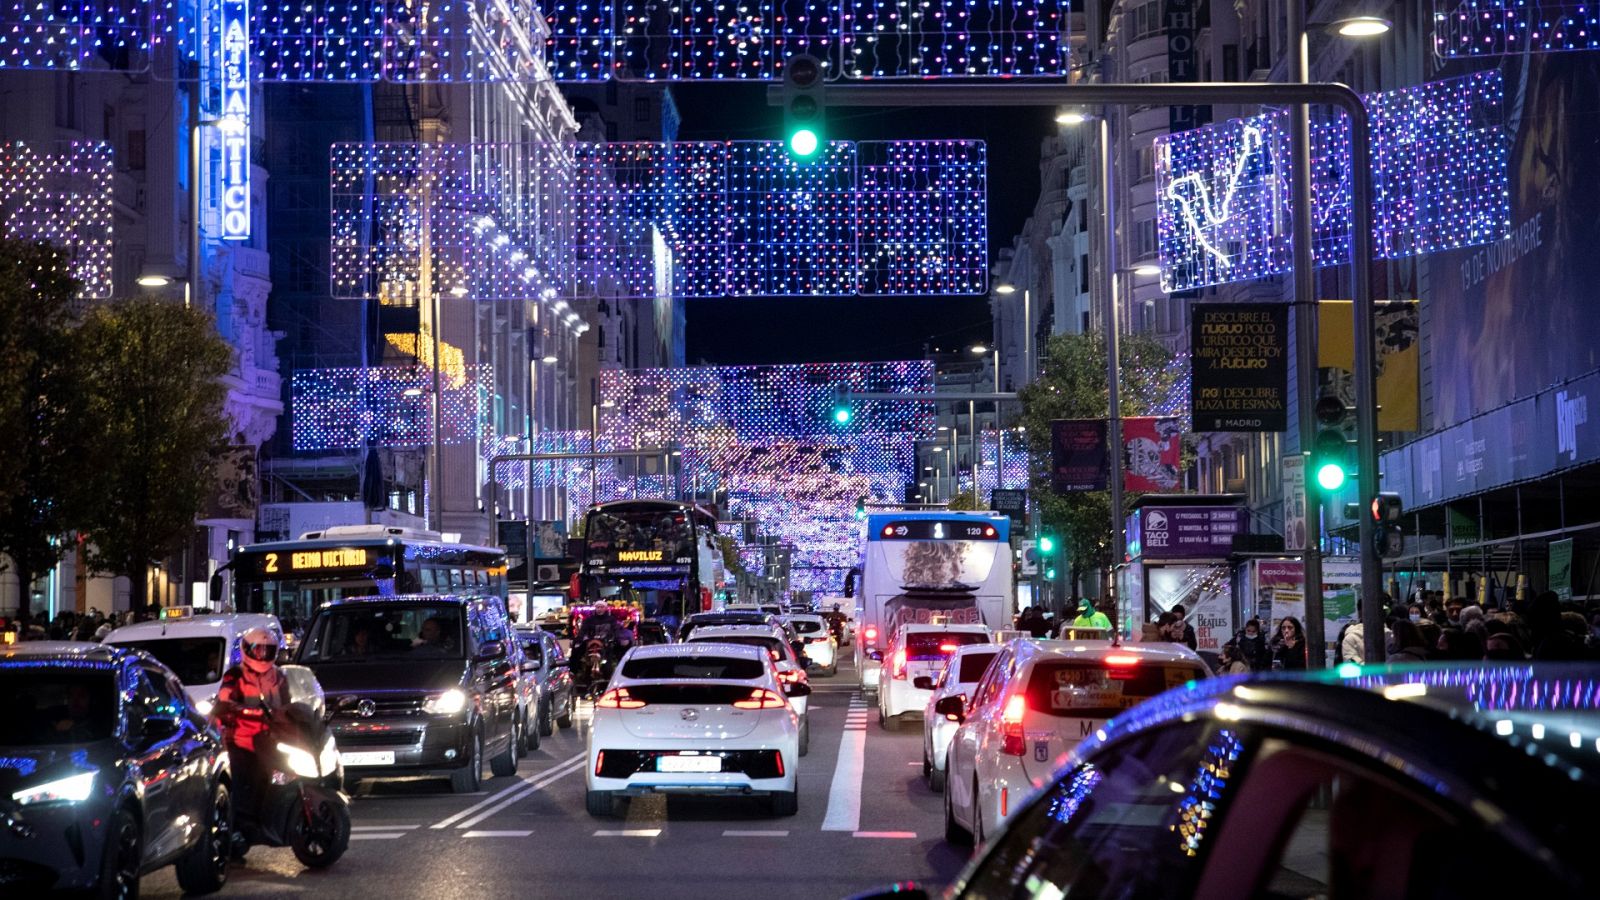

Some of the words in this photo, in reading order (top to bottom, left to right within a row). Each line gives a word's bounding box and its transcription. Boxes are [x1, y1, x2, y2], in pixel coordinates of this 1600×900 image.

[1169, 12, 1191, 122] HOTL
[1460, 261, 1471, 291] 19
[1472, 251, 1485, 283] DE
[1486, 212, 1542, 276] NOVIEMBRE
[1204, 312, 1259, 322] DESCUBRE
[1261, 312, 1272, 322] EL
[1245, 323, 1275, 334] POLO
[1253, 335, 1276, 348] QUE
[1196, 347, 1221, 358] MIRA
[1223, 347, 1257, 358] DESDE
[1258, 347, 1281, 358] HOY
[1223, 387, 1278, 398] DESCUBRE
[1195, 399, 1224, 410] PLAZA
[1226, 399, 1240, 410] DE
[1242, 399, 1282, 410] ESPAÑA
[1225, 419, 1262, 427] MADRID
[934, 522, 944, 539] 1
[966, 527, 981, 535] 120
[1145, 531, 1169, 540] TACO
[1147, 539, 1169, 547] BELL
[265, 553, 278, 572] 2
[292, 551, 321, 569] REINA
[323, 549, 366, 567] VICTORIA
[619, 551, 662, 561] NAVILUZ
[167, 608, 183, 618] TAXI
[1197, 613, 1228, 628] BEATLES
[1198, 627, 1211, 638] GET
[1198, 638, 1219, 649] BACK
[1080, 721, 1093, 736] M
